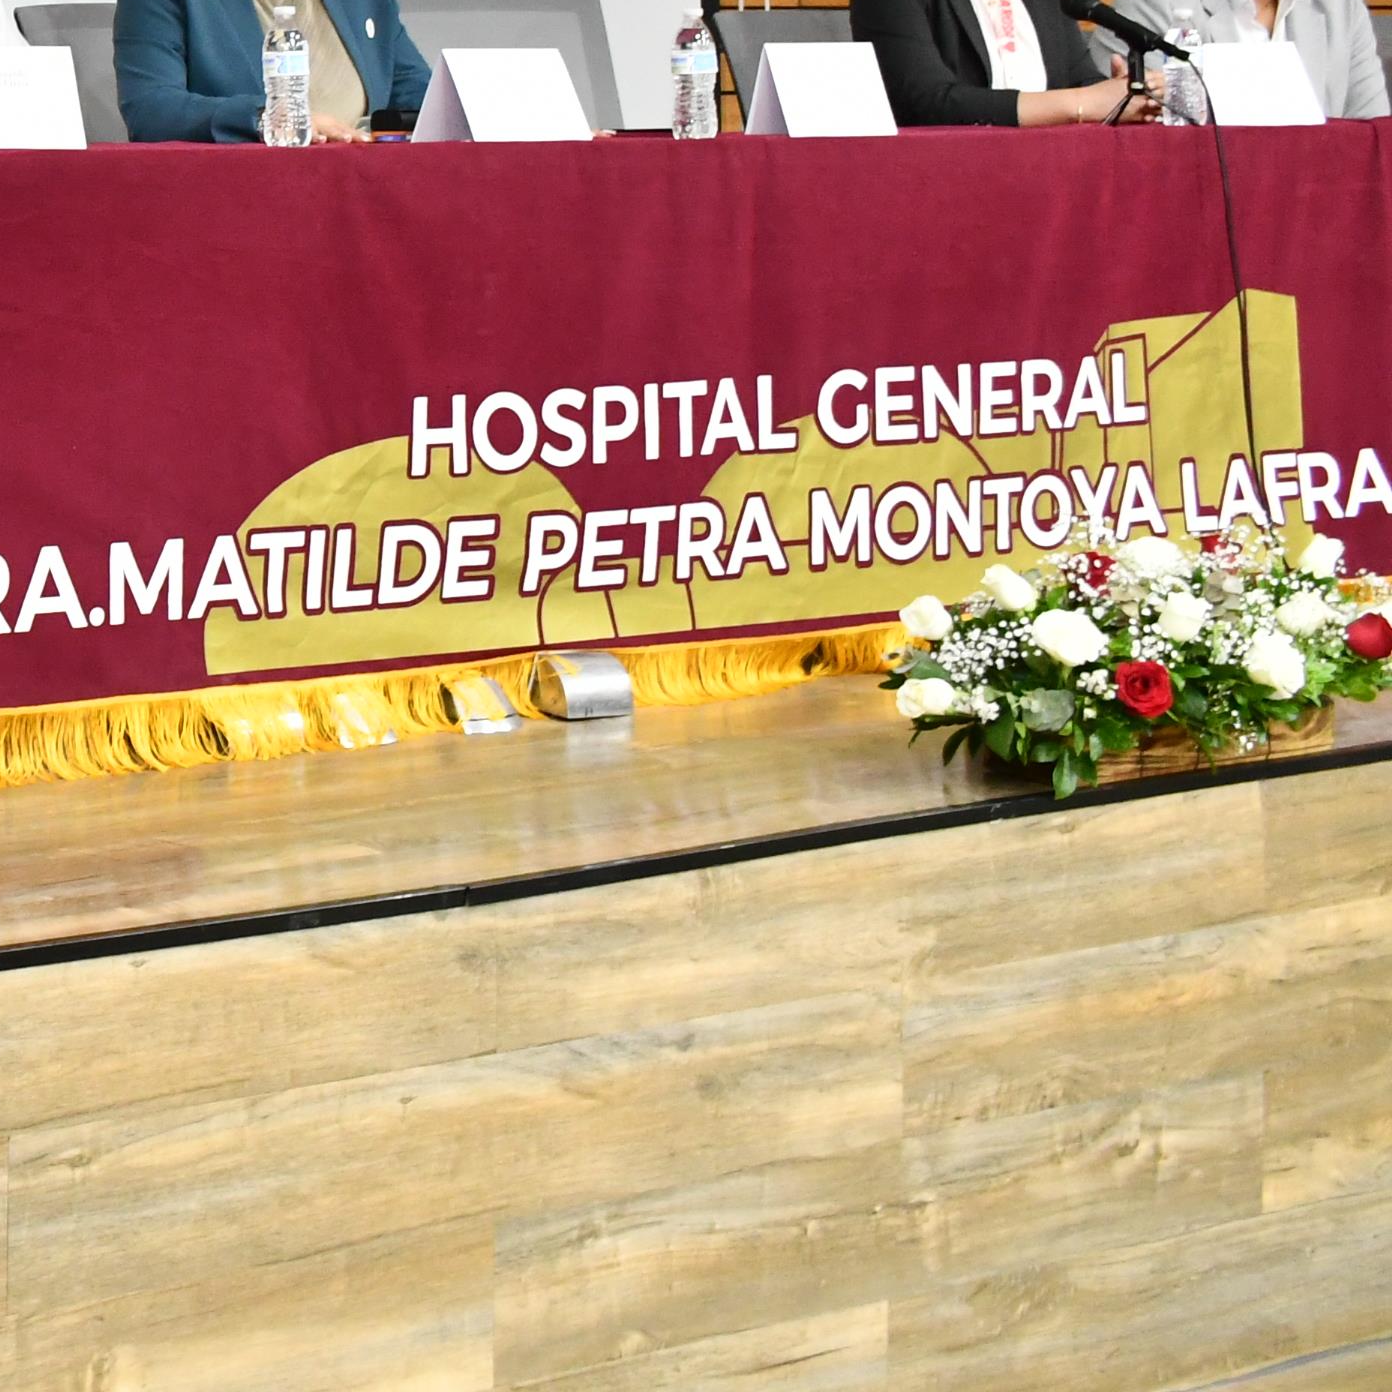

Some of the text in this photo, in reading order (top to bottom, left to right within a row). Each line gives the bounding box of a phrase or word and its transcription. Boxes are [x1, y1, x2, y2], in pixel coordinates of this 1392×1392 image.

[407, 351, 1147, 478] HOSPITAL GENERAL
[523, 495, 788, 593] PETRA
[810, 462, 1166, 566] MONTOYA
